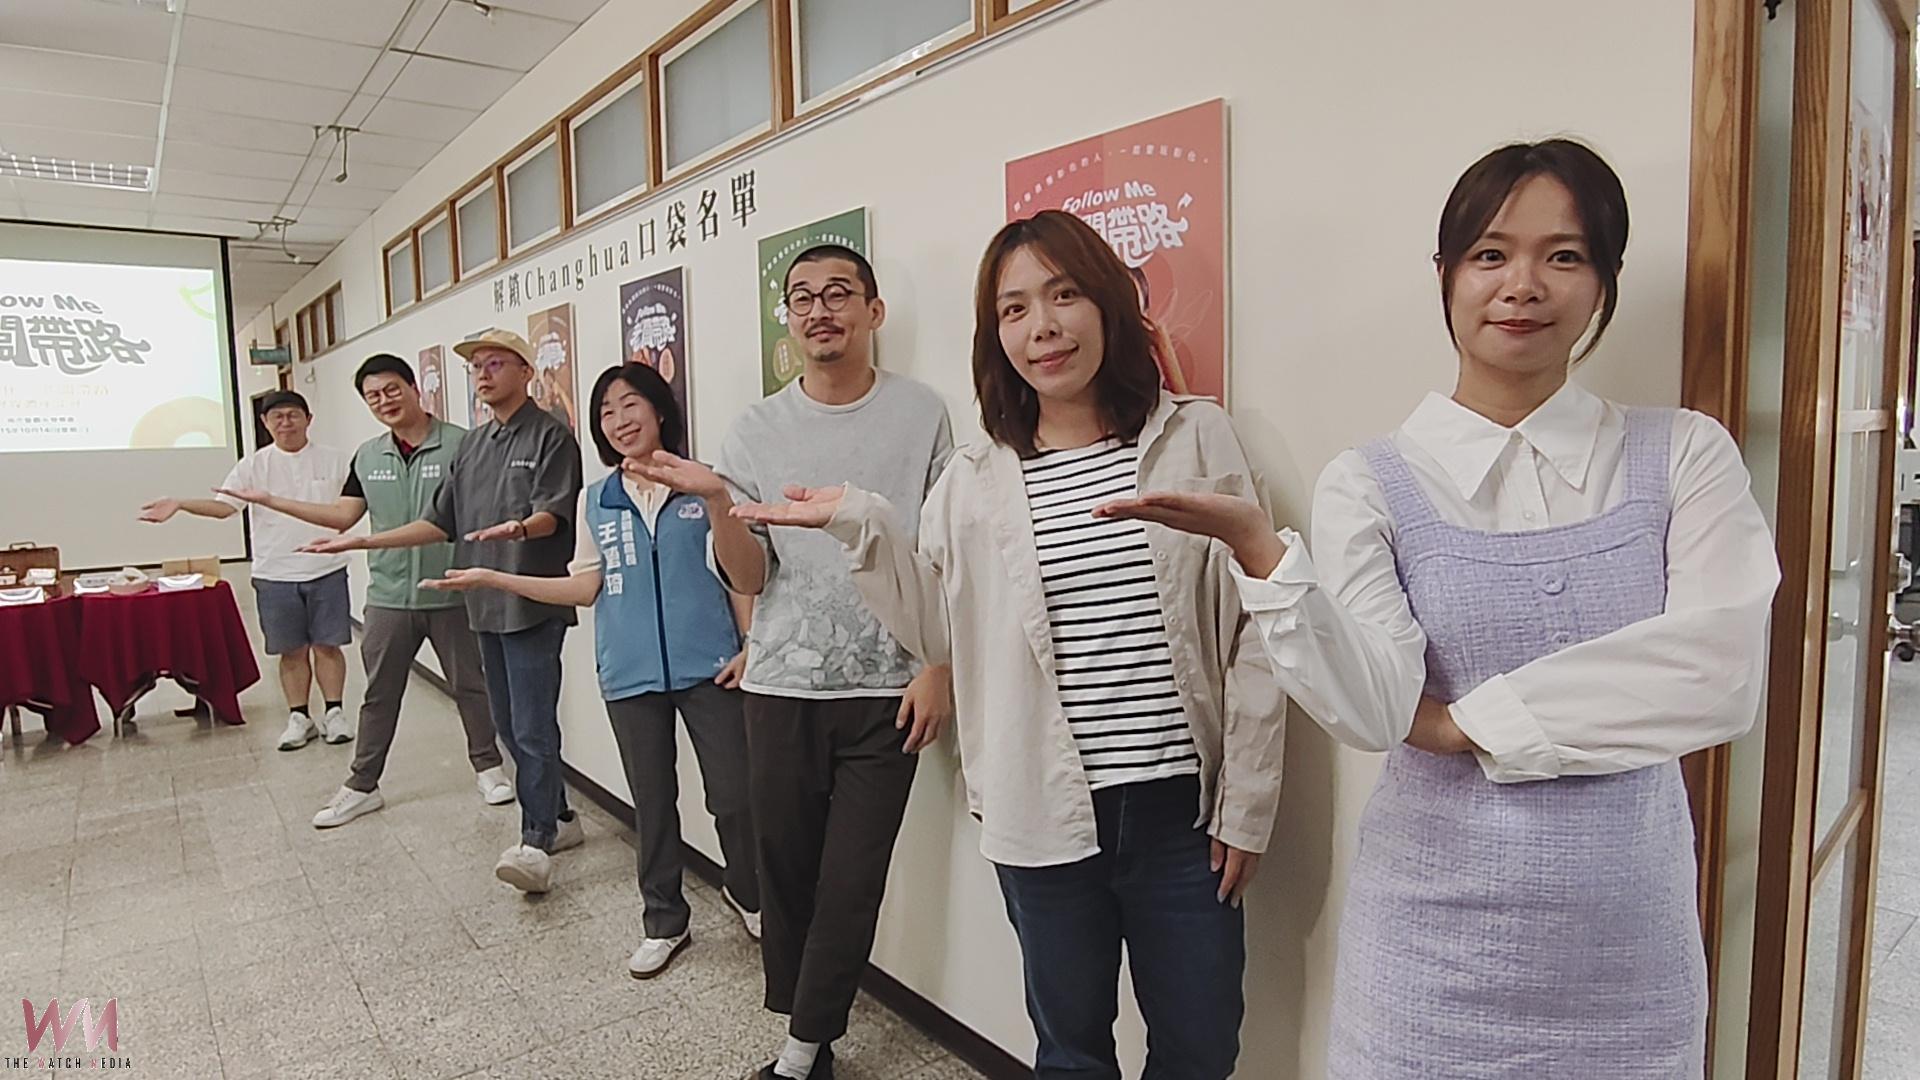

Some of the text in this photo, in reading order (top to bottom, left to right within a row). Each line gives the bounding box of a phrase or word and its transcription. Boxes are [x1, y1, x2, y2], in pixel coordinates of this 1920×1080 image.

[1061, 181, 1157, 213] Follow Me
[53, 294, 103, 314] Me
